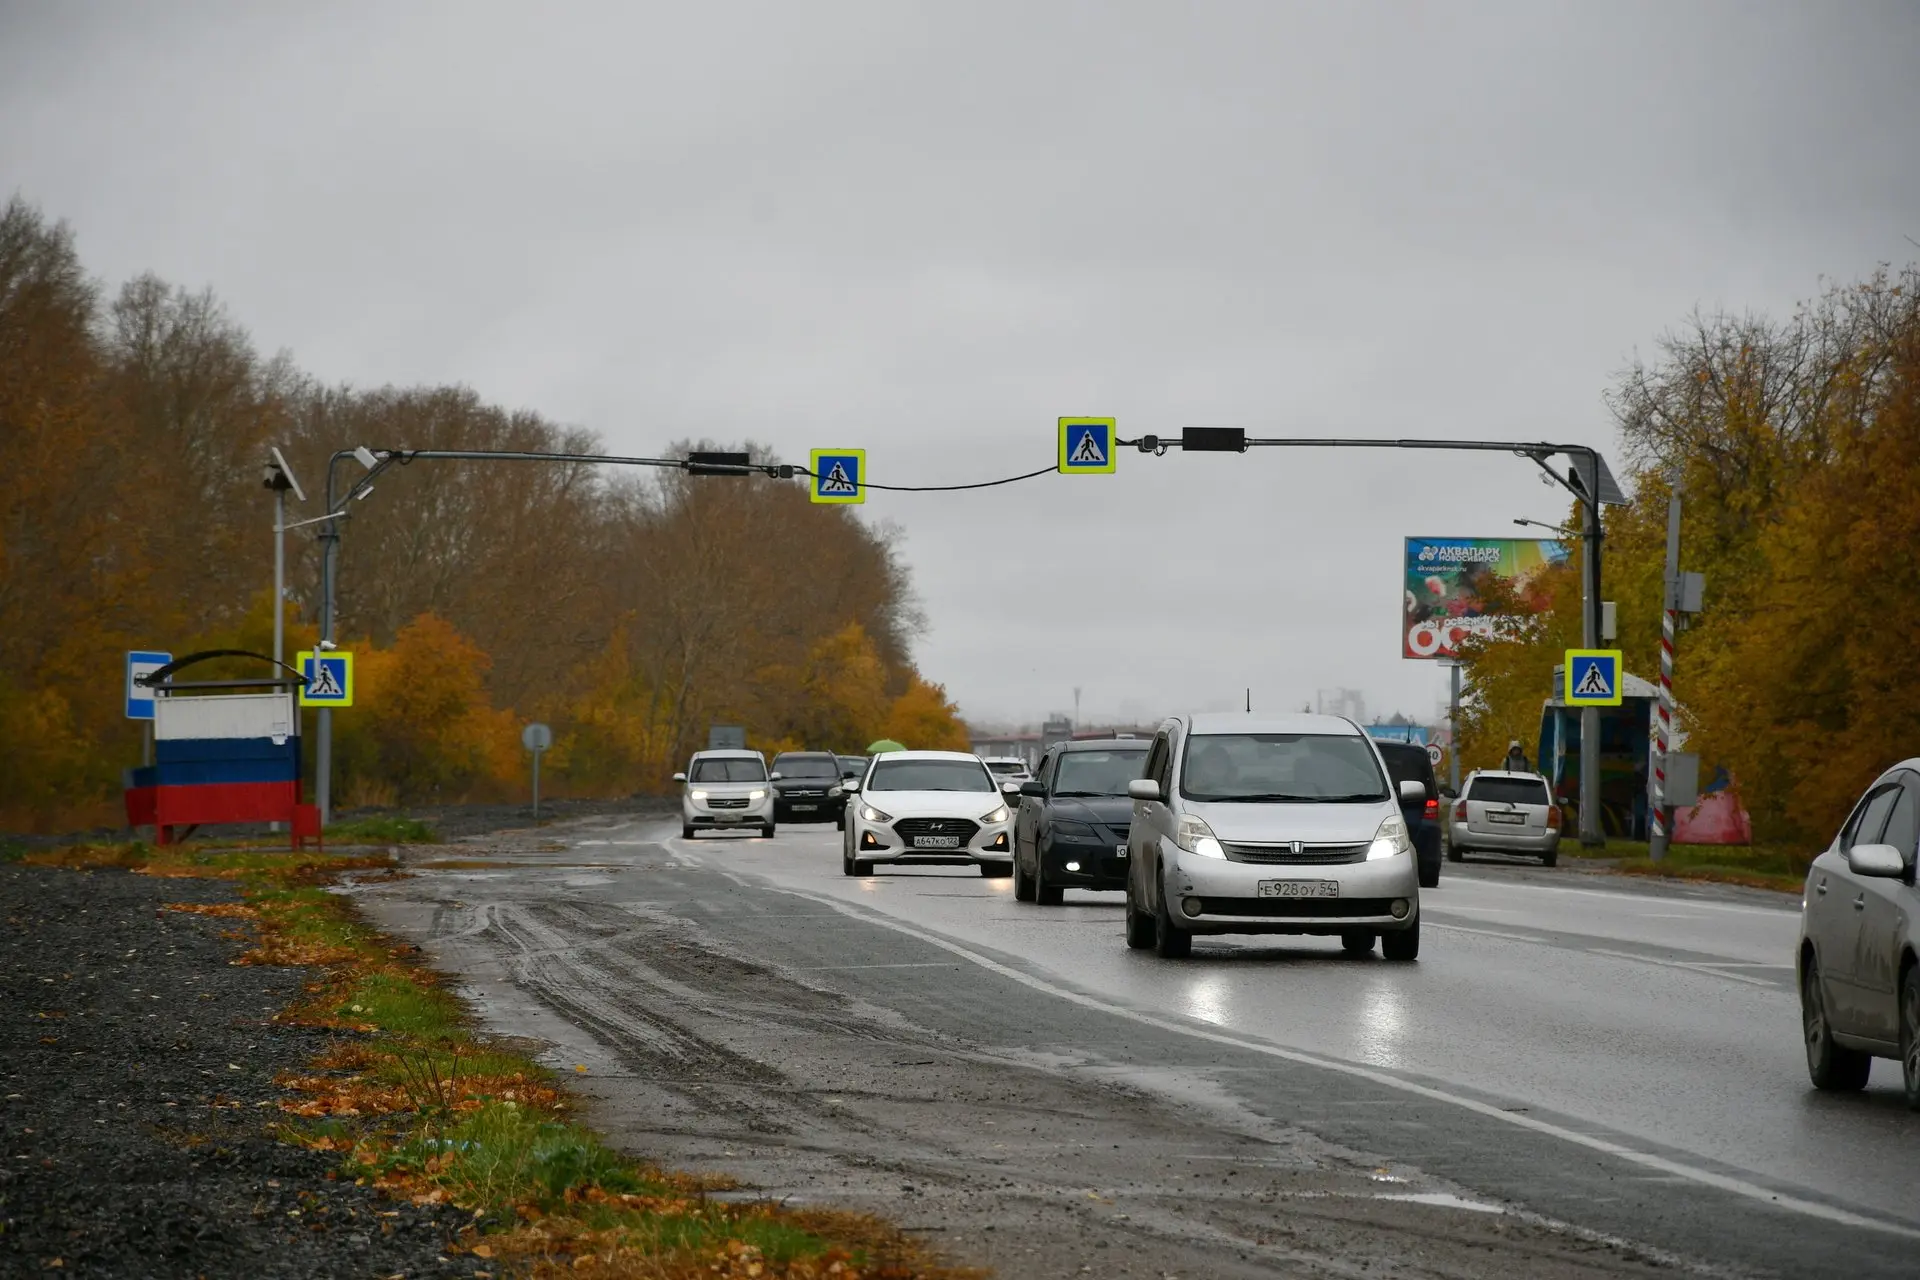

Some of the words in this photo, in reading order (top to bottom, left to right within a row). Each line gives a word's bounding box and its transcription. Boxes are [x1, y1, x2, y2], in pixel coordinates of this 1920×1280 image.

[1439, 546, 1500, 557] АКВАПАРК
[1439, 555, 1500, 563] НОВОСИБИРСК
[1264, 882, 1317, 896] Е928ОУ
